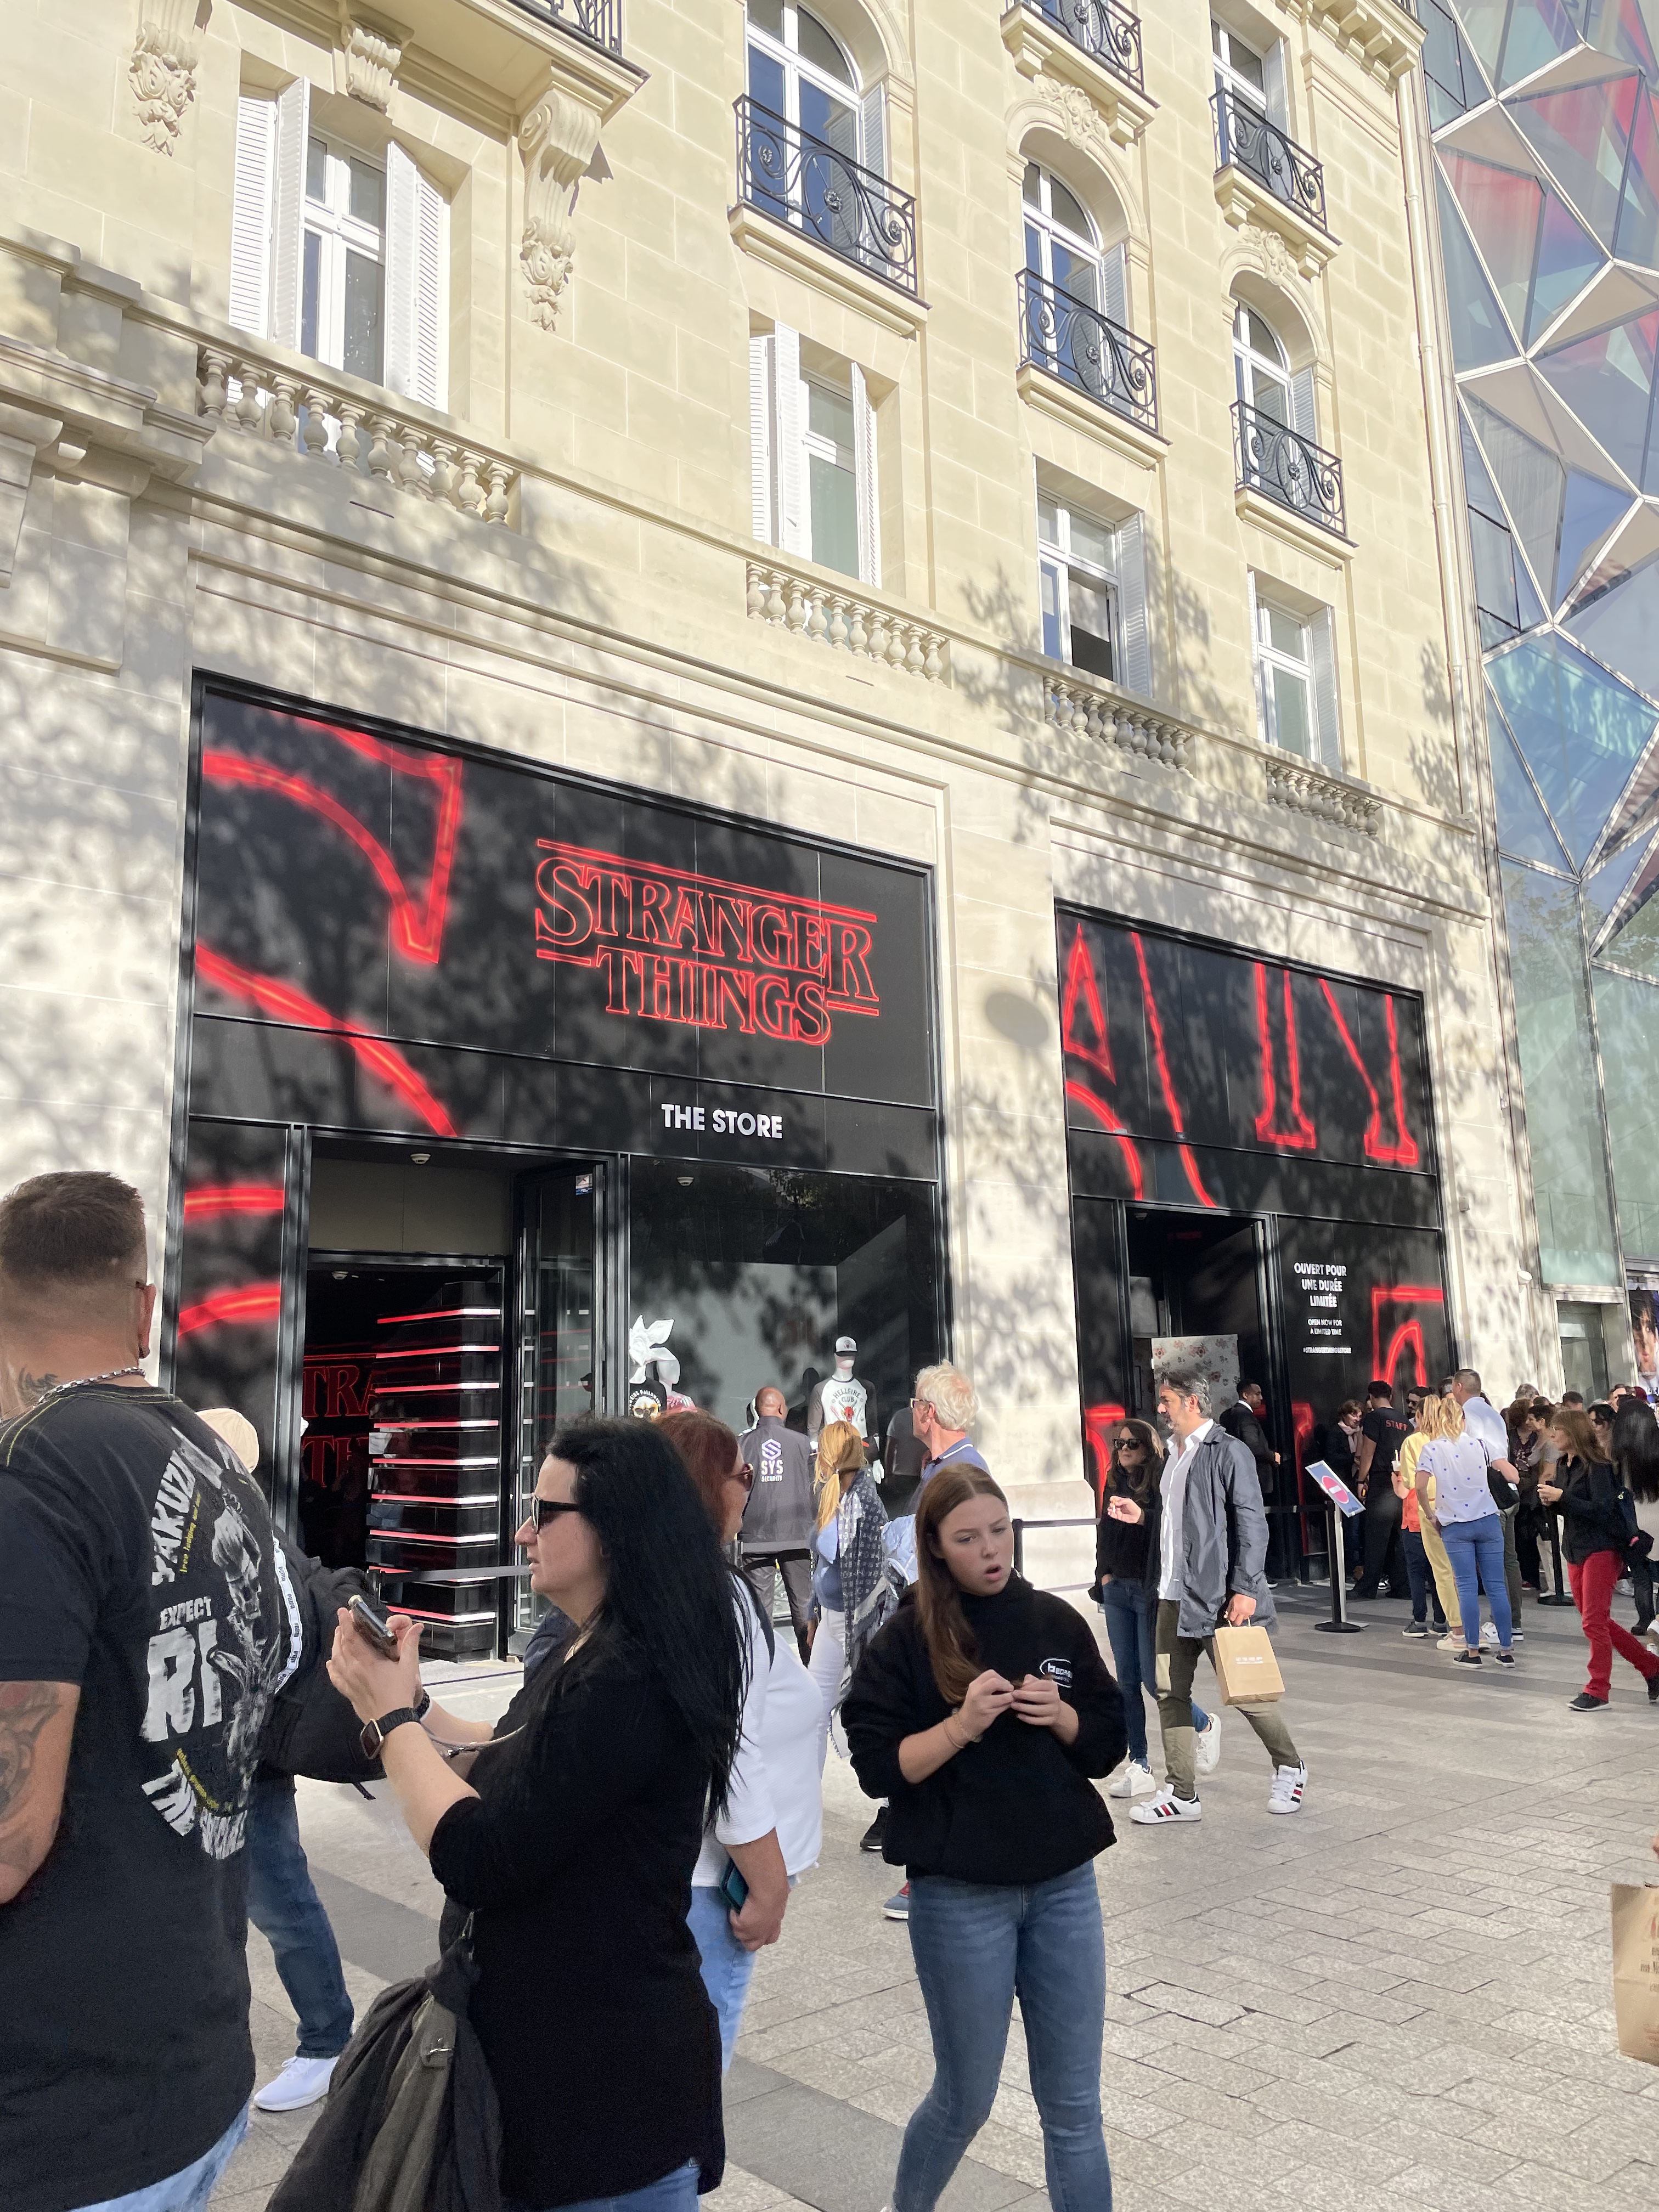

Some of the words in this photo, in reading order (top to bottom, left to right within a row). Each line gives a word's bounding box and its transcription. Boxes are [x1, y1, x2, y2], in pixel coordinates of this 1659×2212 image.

[535, 857, 879, 1002] STRANGER
[596, 945, 832, 1046] THINGS
[661, 1103, 705, 1131] THE
[713, 1109, 782, 1139] STORE
[1294, 1262, 1324, 1275] OUVERT
[1325, 1265, 1347, 1276] POUR
[1302, 1279, 1317, 1290] UNE
[1318, 1278, 1342, 1291] DURÉE
[1310, 1293, 1338, 1307] LIMITÉE
[833, 1388, 861, 1399] HELLFIRE
[1386, 1419, 1408, 1431] STAFF
[761, 1459, 783, 1475] SYS
[159, 1596, 212, 1631] EXPECT
